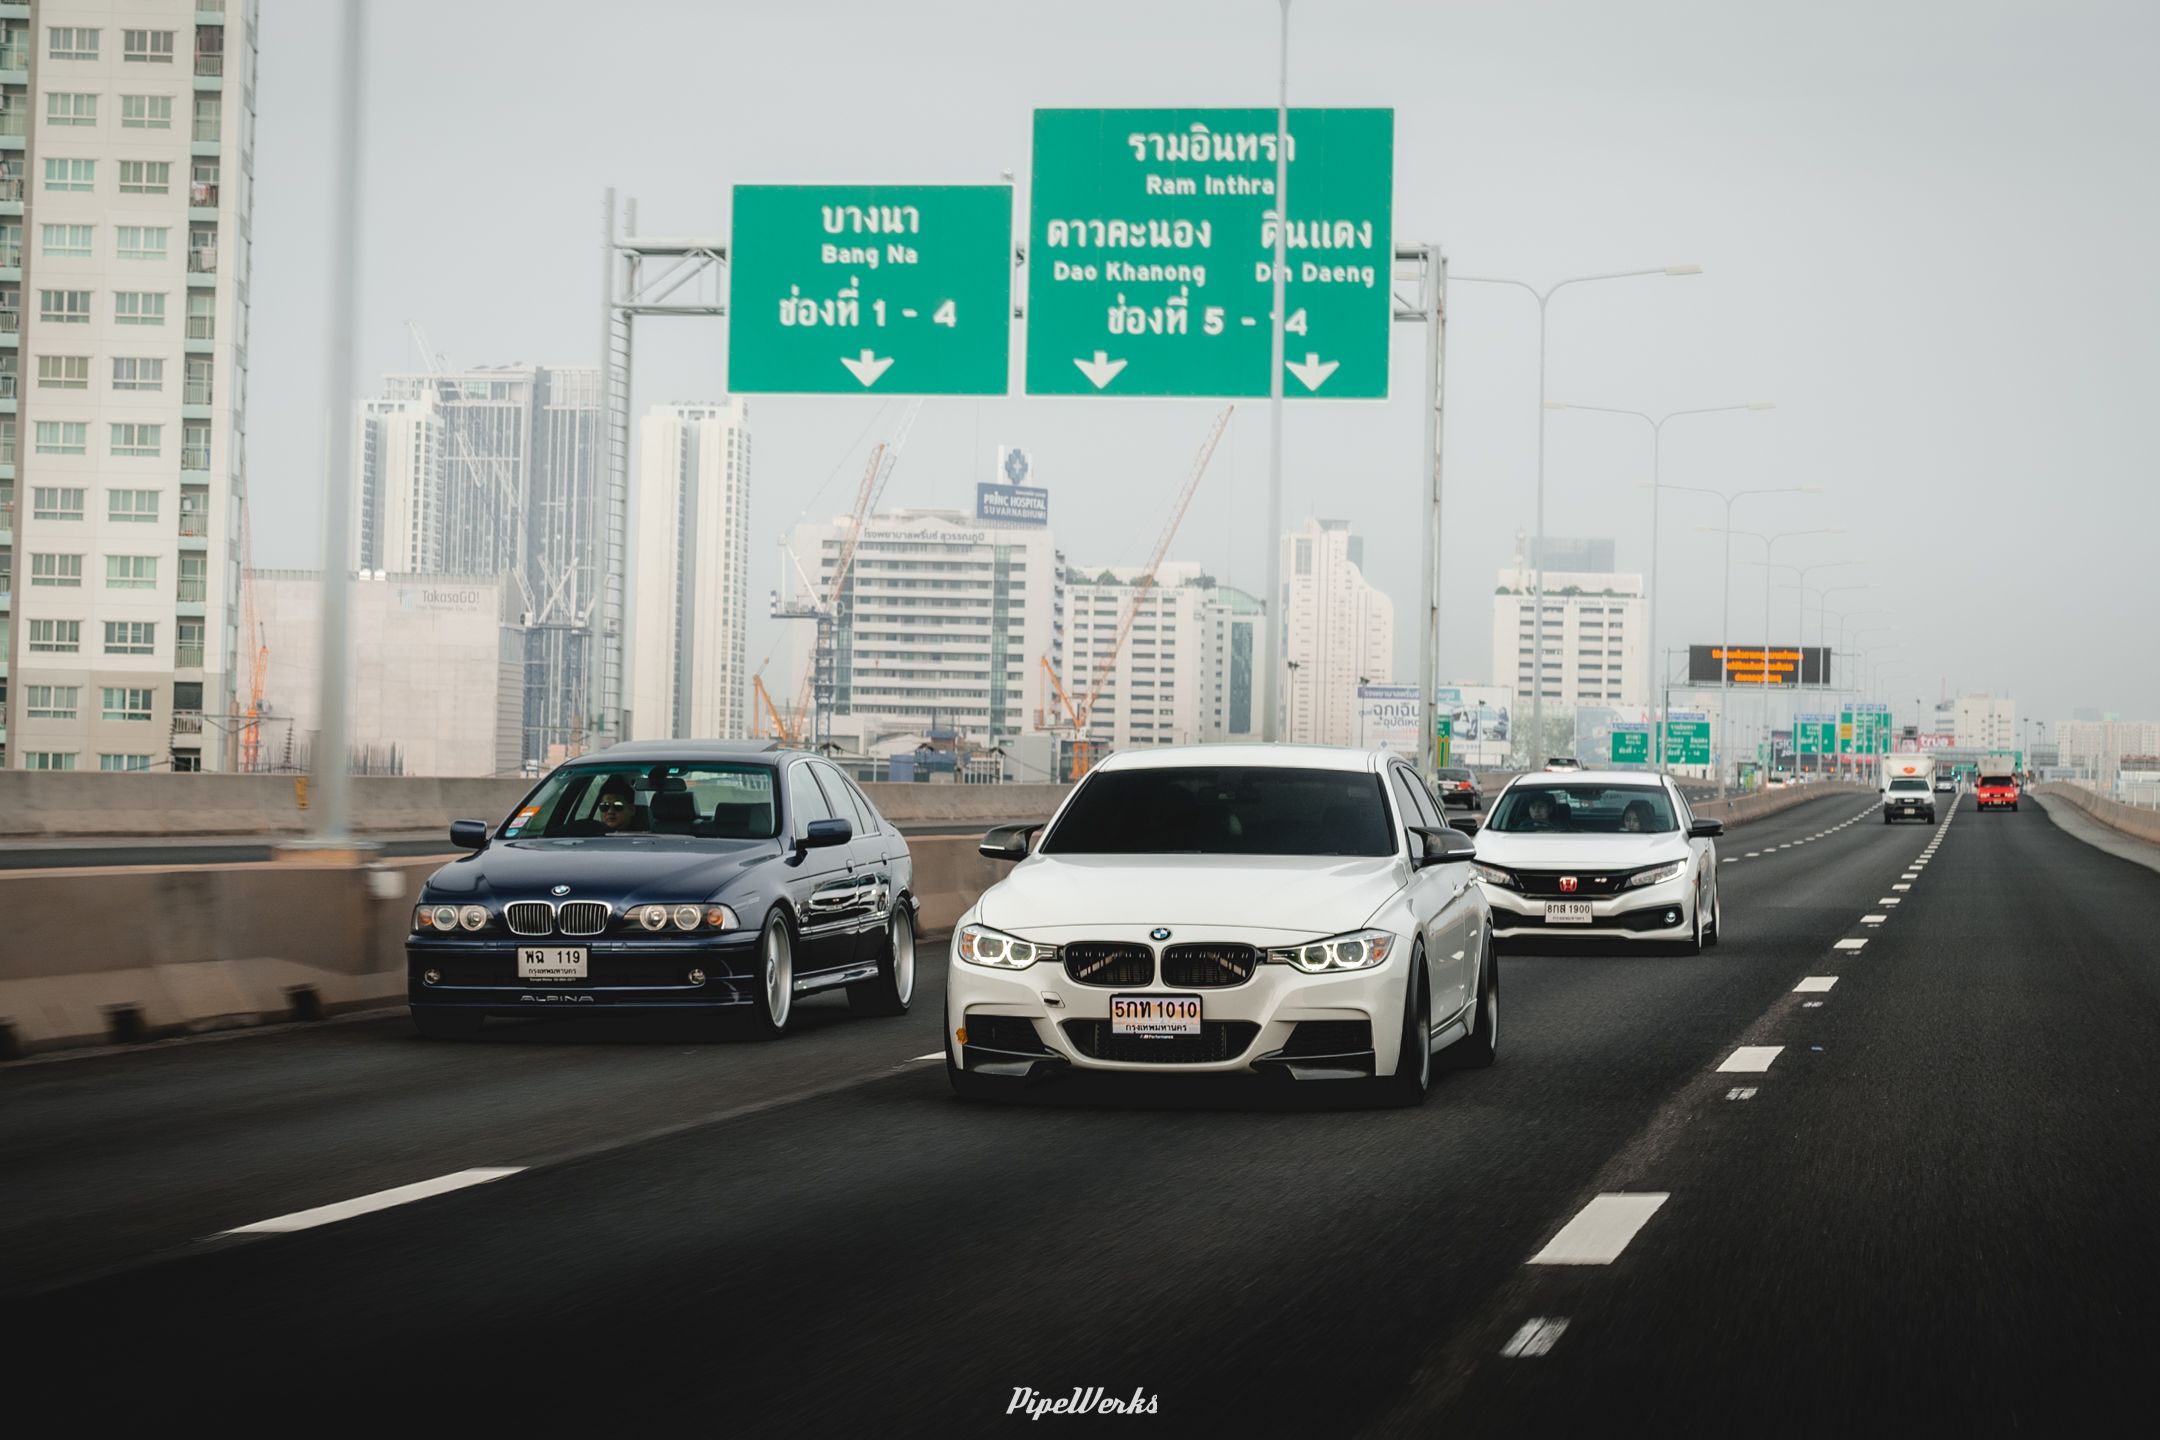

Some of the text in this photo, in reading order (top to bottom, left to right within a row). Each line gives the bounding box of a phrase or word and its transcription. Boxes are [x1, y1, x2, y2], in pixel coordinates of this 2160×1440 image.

[1127, 121, 1296, 162] รามอินทรา
[1145, 174, 1276, 195] Ram Inthra
[821, 205, 920, 234] บางนา
[1046, 219, 1212, 248] ดาวคะนอง
[821, 244, 919, 270] Bang Na
[1053, 261, 1207, 288] Dao Khanong
[1301, 261, 1375, 289] Daeng
[778, 275, 958, 328] ช่องที่ 1 - 4
[1107, 285, 1189, 335] ช่องที่
[1202, 306, 1226, 336] 5
[1240, 316, 1257, 326] -
[1010, 495, 1047, 510] HOSPITAL
[422, 589, 480, 604] TakasaGO!
[1569, 904, 1590, 914] 1900
[557, 950, 581, 964] 119
[1114, 1000, 1197, 1019] 5กท 1010
[1125, 1024, 1187, 1034] กรุงเทพมหานคร
